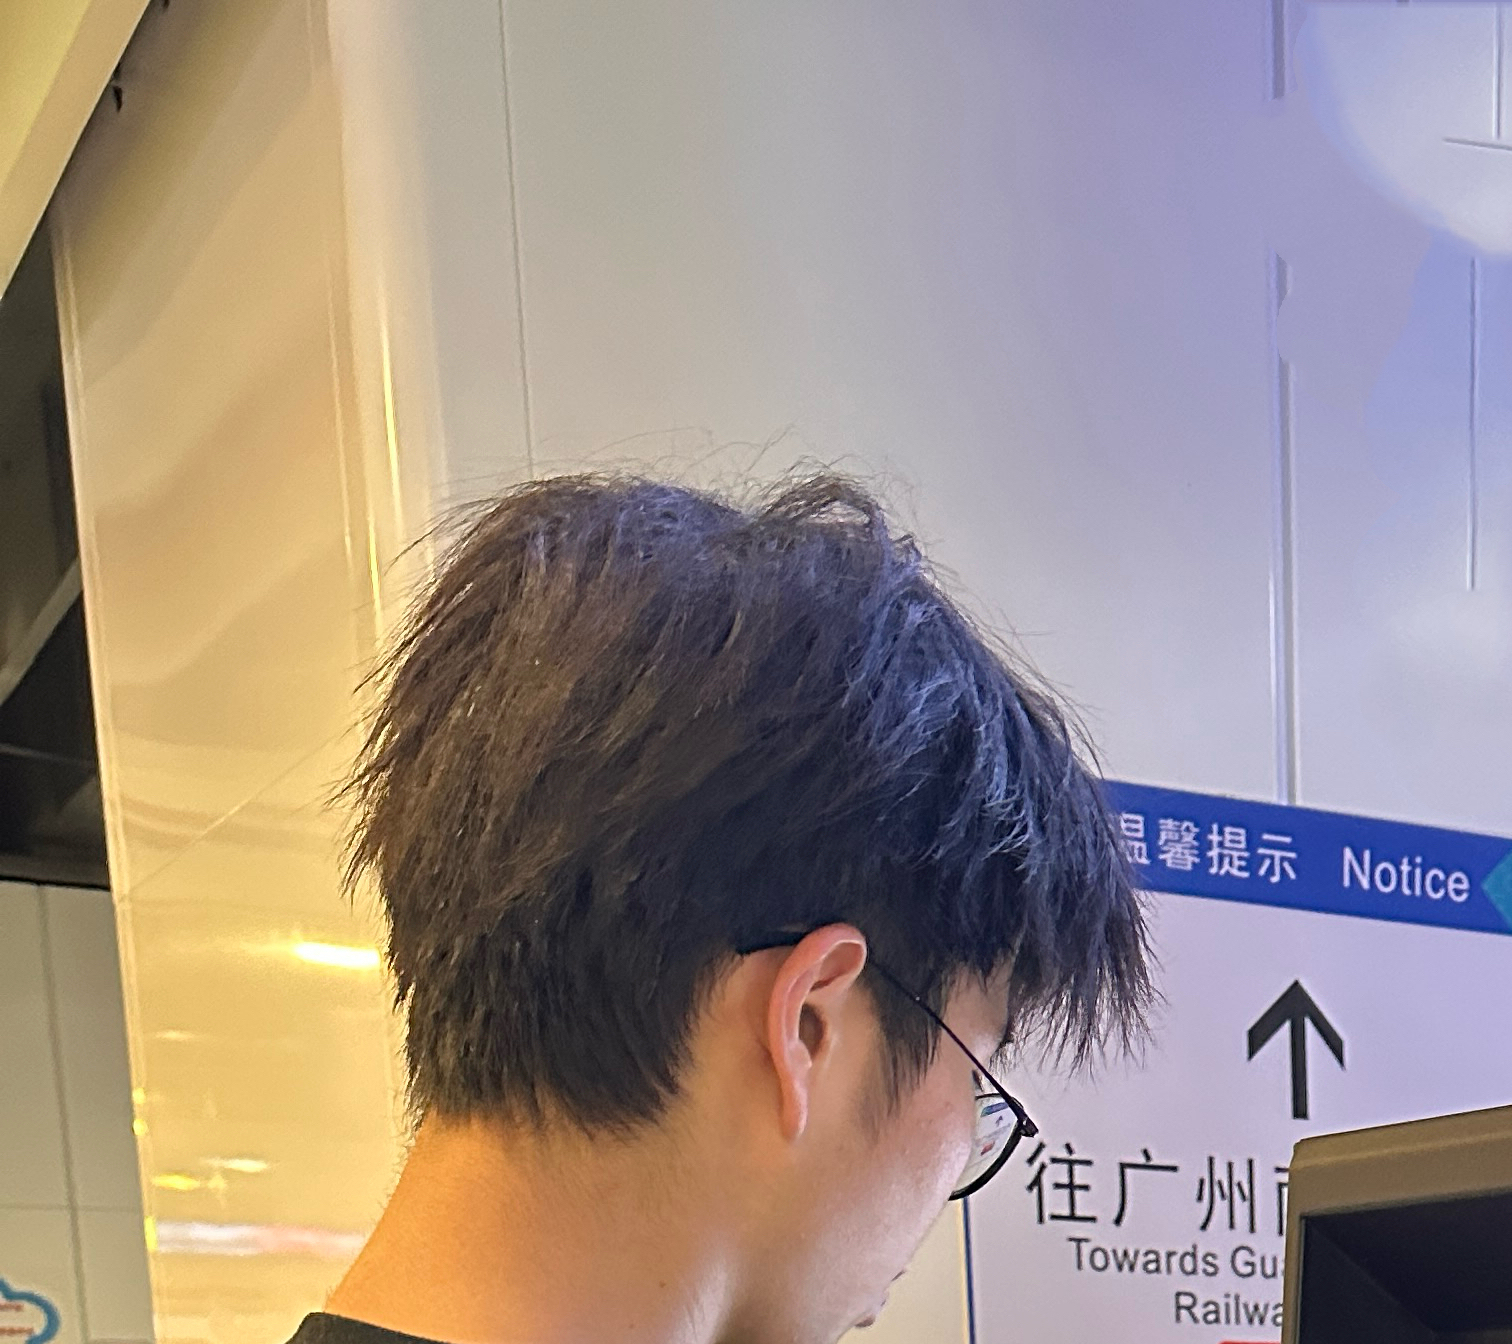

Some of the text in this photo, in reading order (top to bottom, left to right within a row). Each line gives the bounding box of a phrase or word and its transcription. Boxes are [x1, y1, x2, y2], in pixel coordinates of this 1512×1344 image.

[1343, 846, 1470, 902] Notice
[1026, 1142, 1289, 1237] 往广州
[1067, 1237, 1285, 1280] Towards Gu
